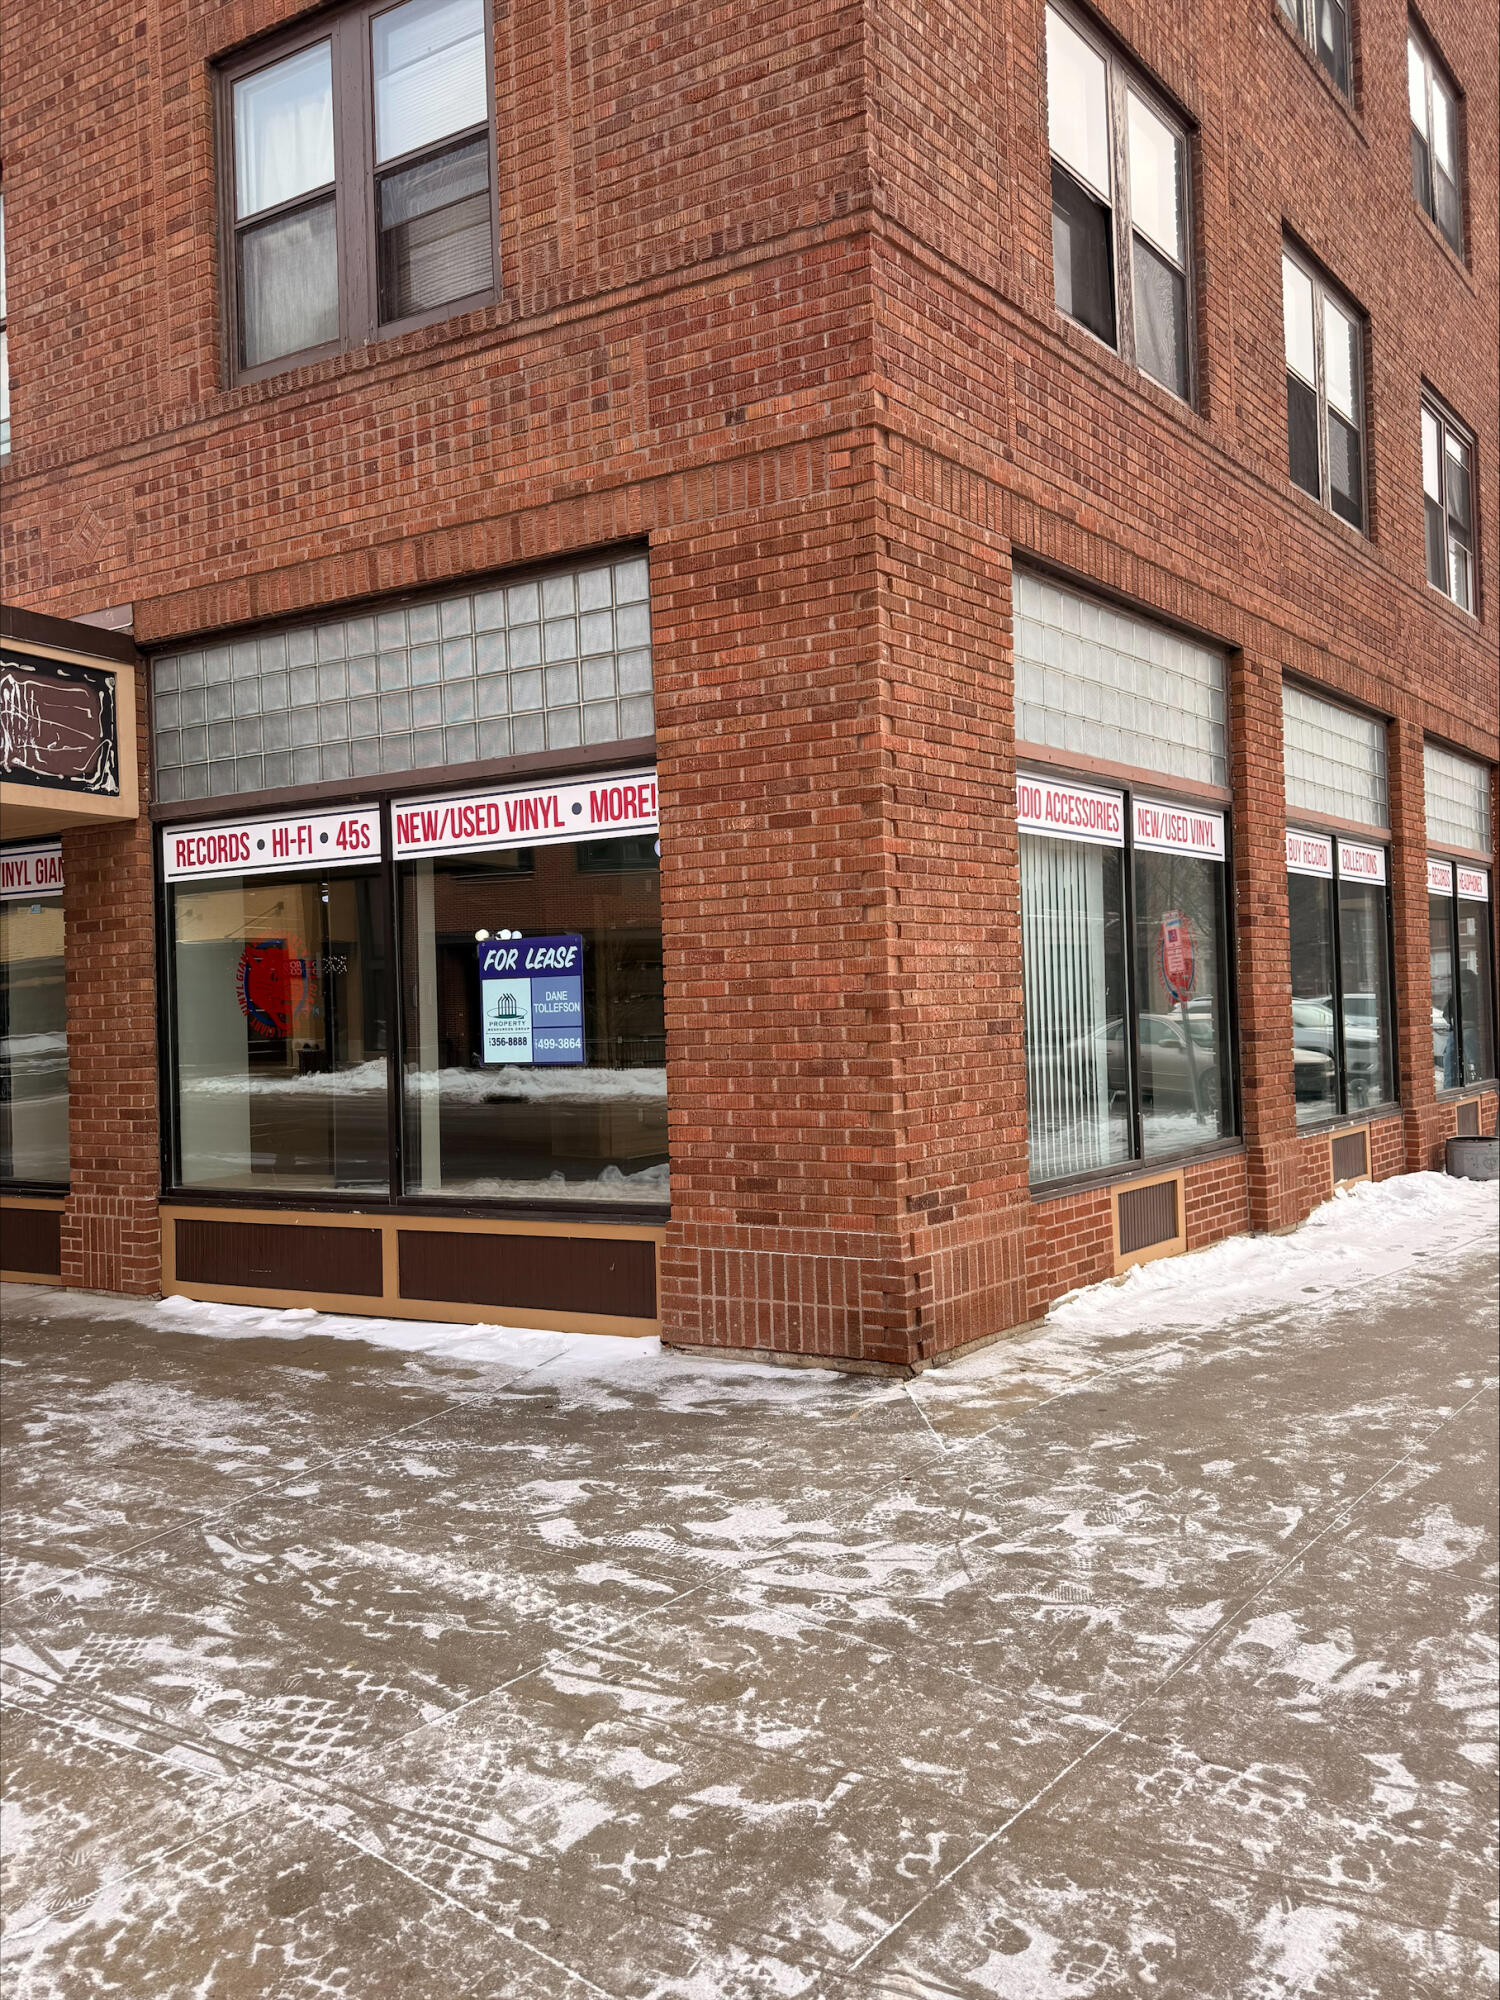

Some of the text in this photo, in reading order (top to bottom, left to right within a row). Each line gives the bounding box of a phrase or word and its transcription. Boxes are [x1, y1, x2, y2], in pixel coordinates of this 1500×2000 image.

[397, 783, 657, 845] NEW/USED VINYL MORE!
[1045, 791, 1119, 833] ACCESSORIES
[1137, 807, 1215, 847] NEW/USED VINYL
[176, 820, 370, 867] RECORDS HI-FI 45s
[1288, 838, 1327, 867] BUY RECORD
[1342, 848, 1377, 875] COLLECTIONS
[484, 946, 578, 971] FOR LEASE
[533, 1002, 580, 1013] TOLLEFSON
[545, 991, 568, 1001] DANE
[491, 1037, 528, 1047] 356-8888
[537, 1038, 581, 1049] 499-3864
